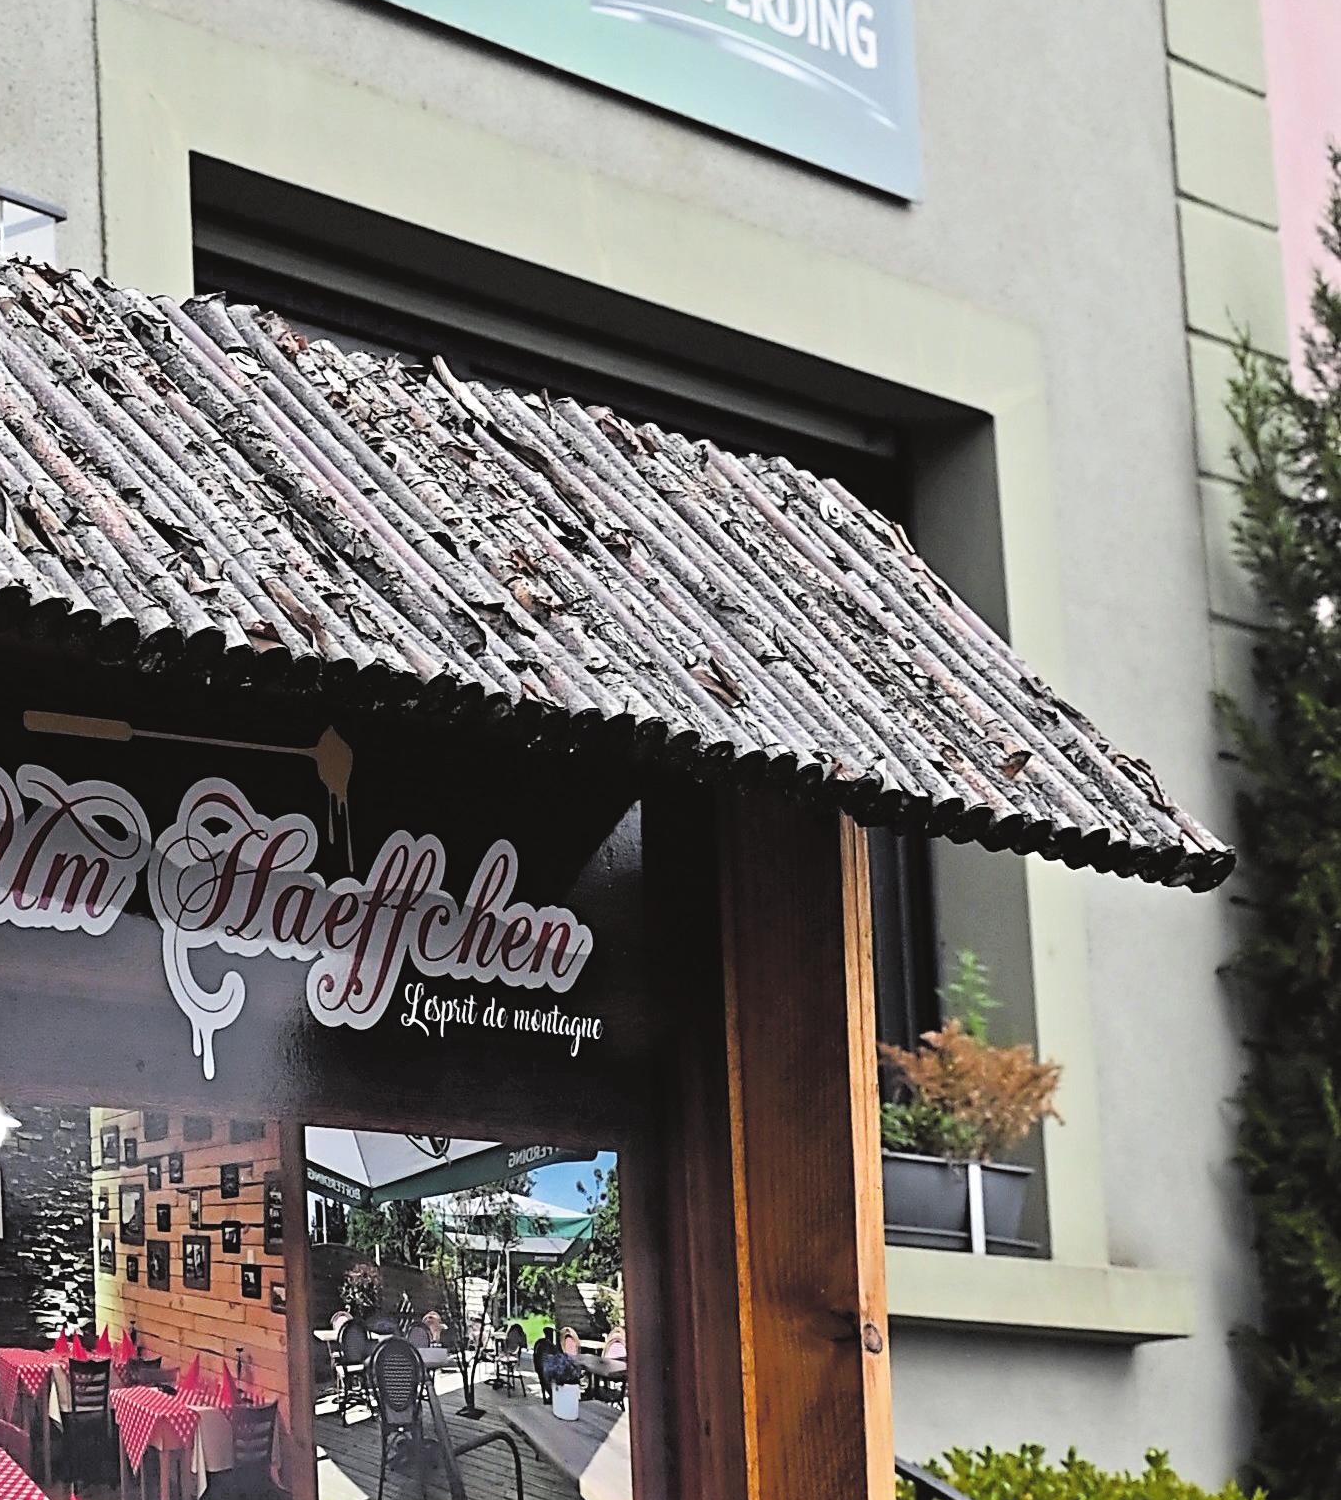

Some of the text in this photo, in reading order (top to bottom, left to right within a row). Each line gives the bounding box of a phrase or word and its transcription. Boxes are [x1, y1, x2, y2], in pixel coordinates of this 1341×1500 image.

[158, 792, 589, 1013] Haeffchen
[482, 997, 508, 1029] de
[514, 1005, 603, 1057] montagne
